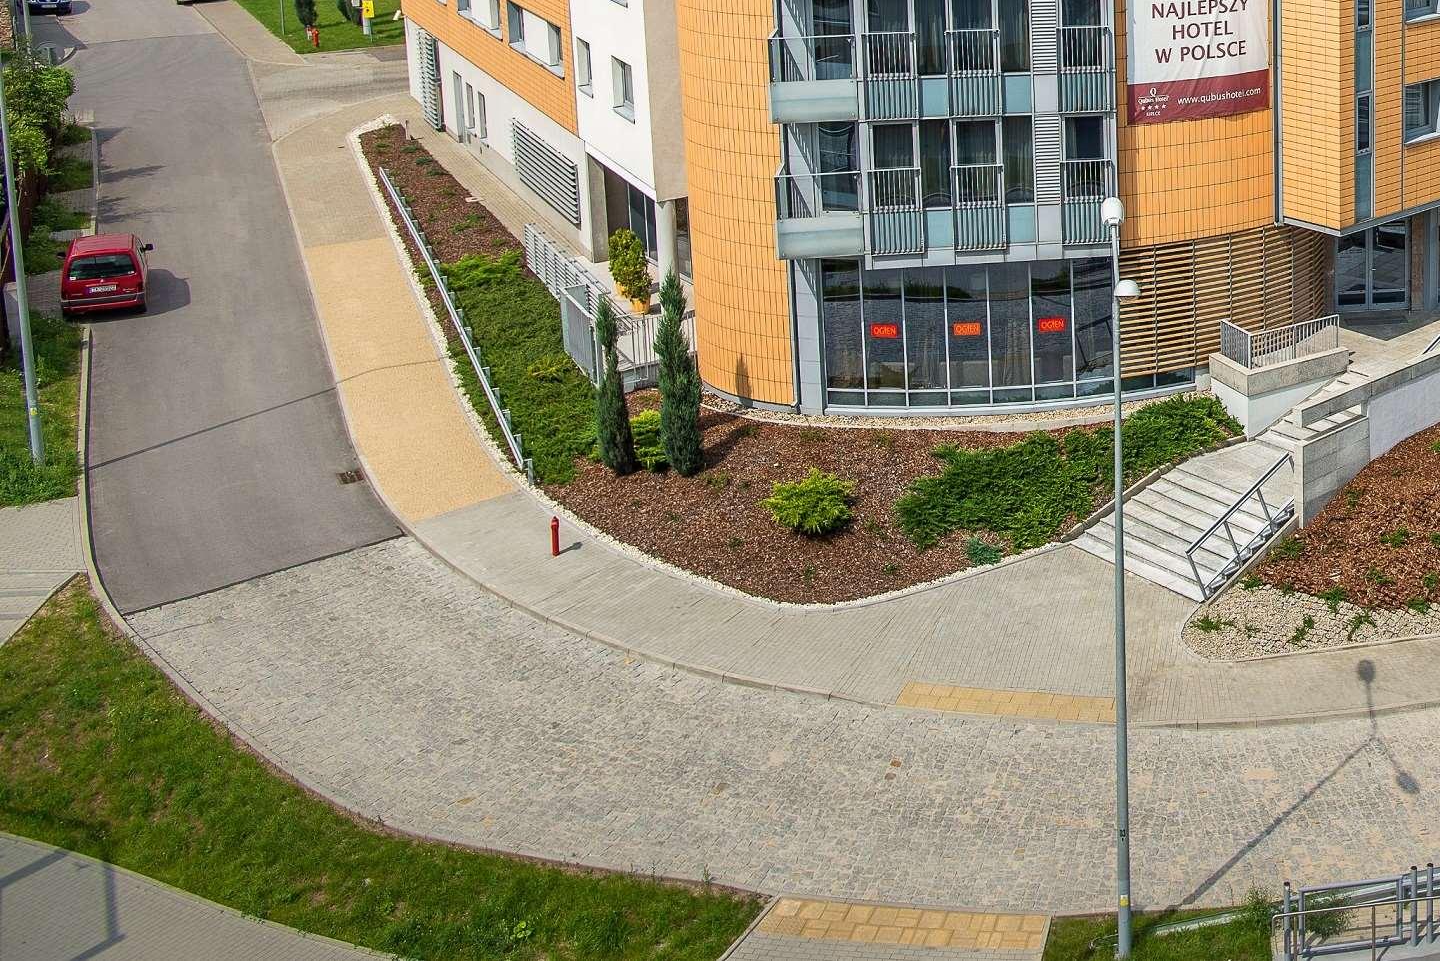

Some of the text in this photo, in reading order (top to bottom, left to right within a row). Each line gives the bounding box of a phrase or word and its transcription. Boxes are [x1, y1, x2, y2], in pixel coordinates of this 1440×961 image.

[1172, 20, 1234, 40] HOTEL
[1154, 40, 1247, 64] W POLSCE
